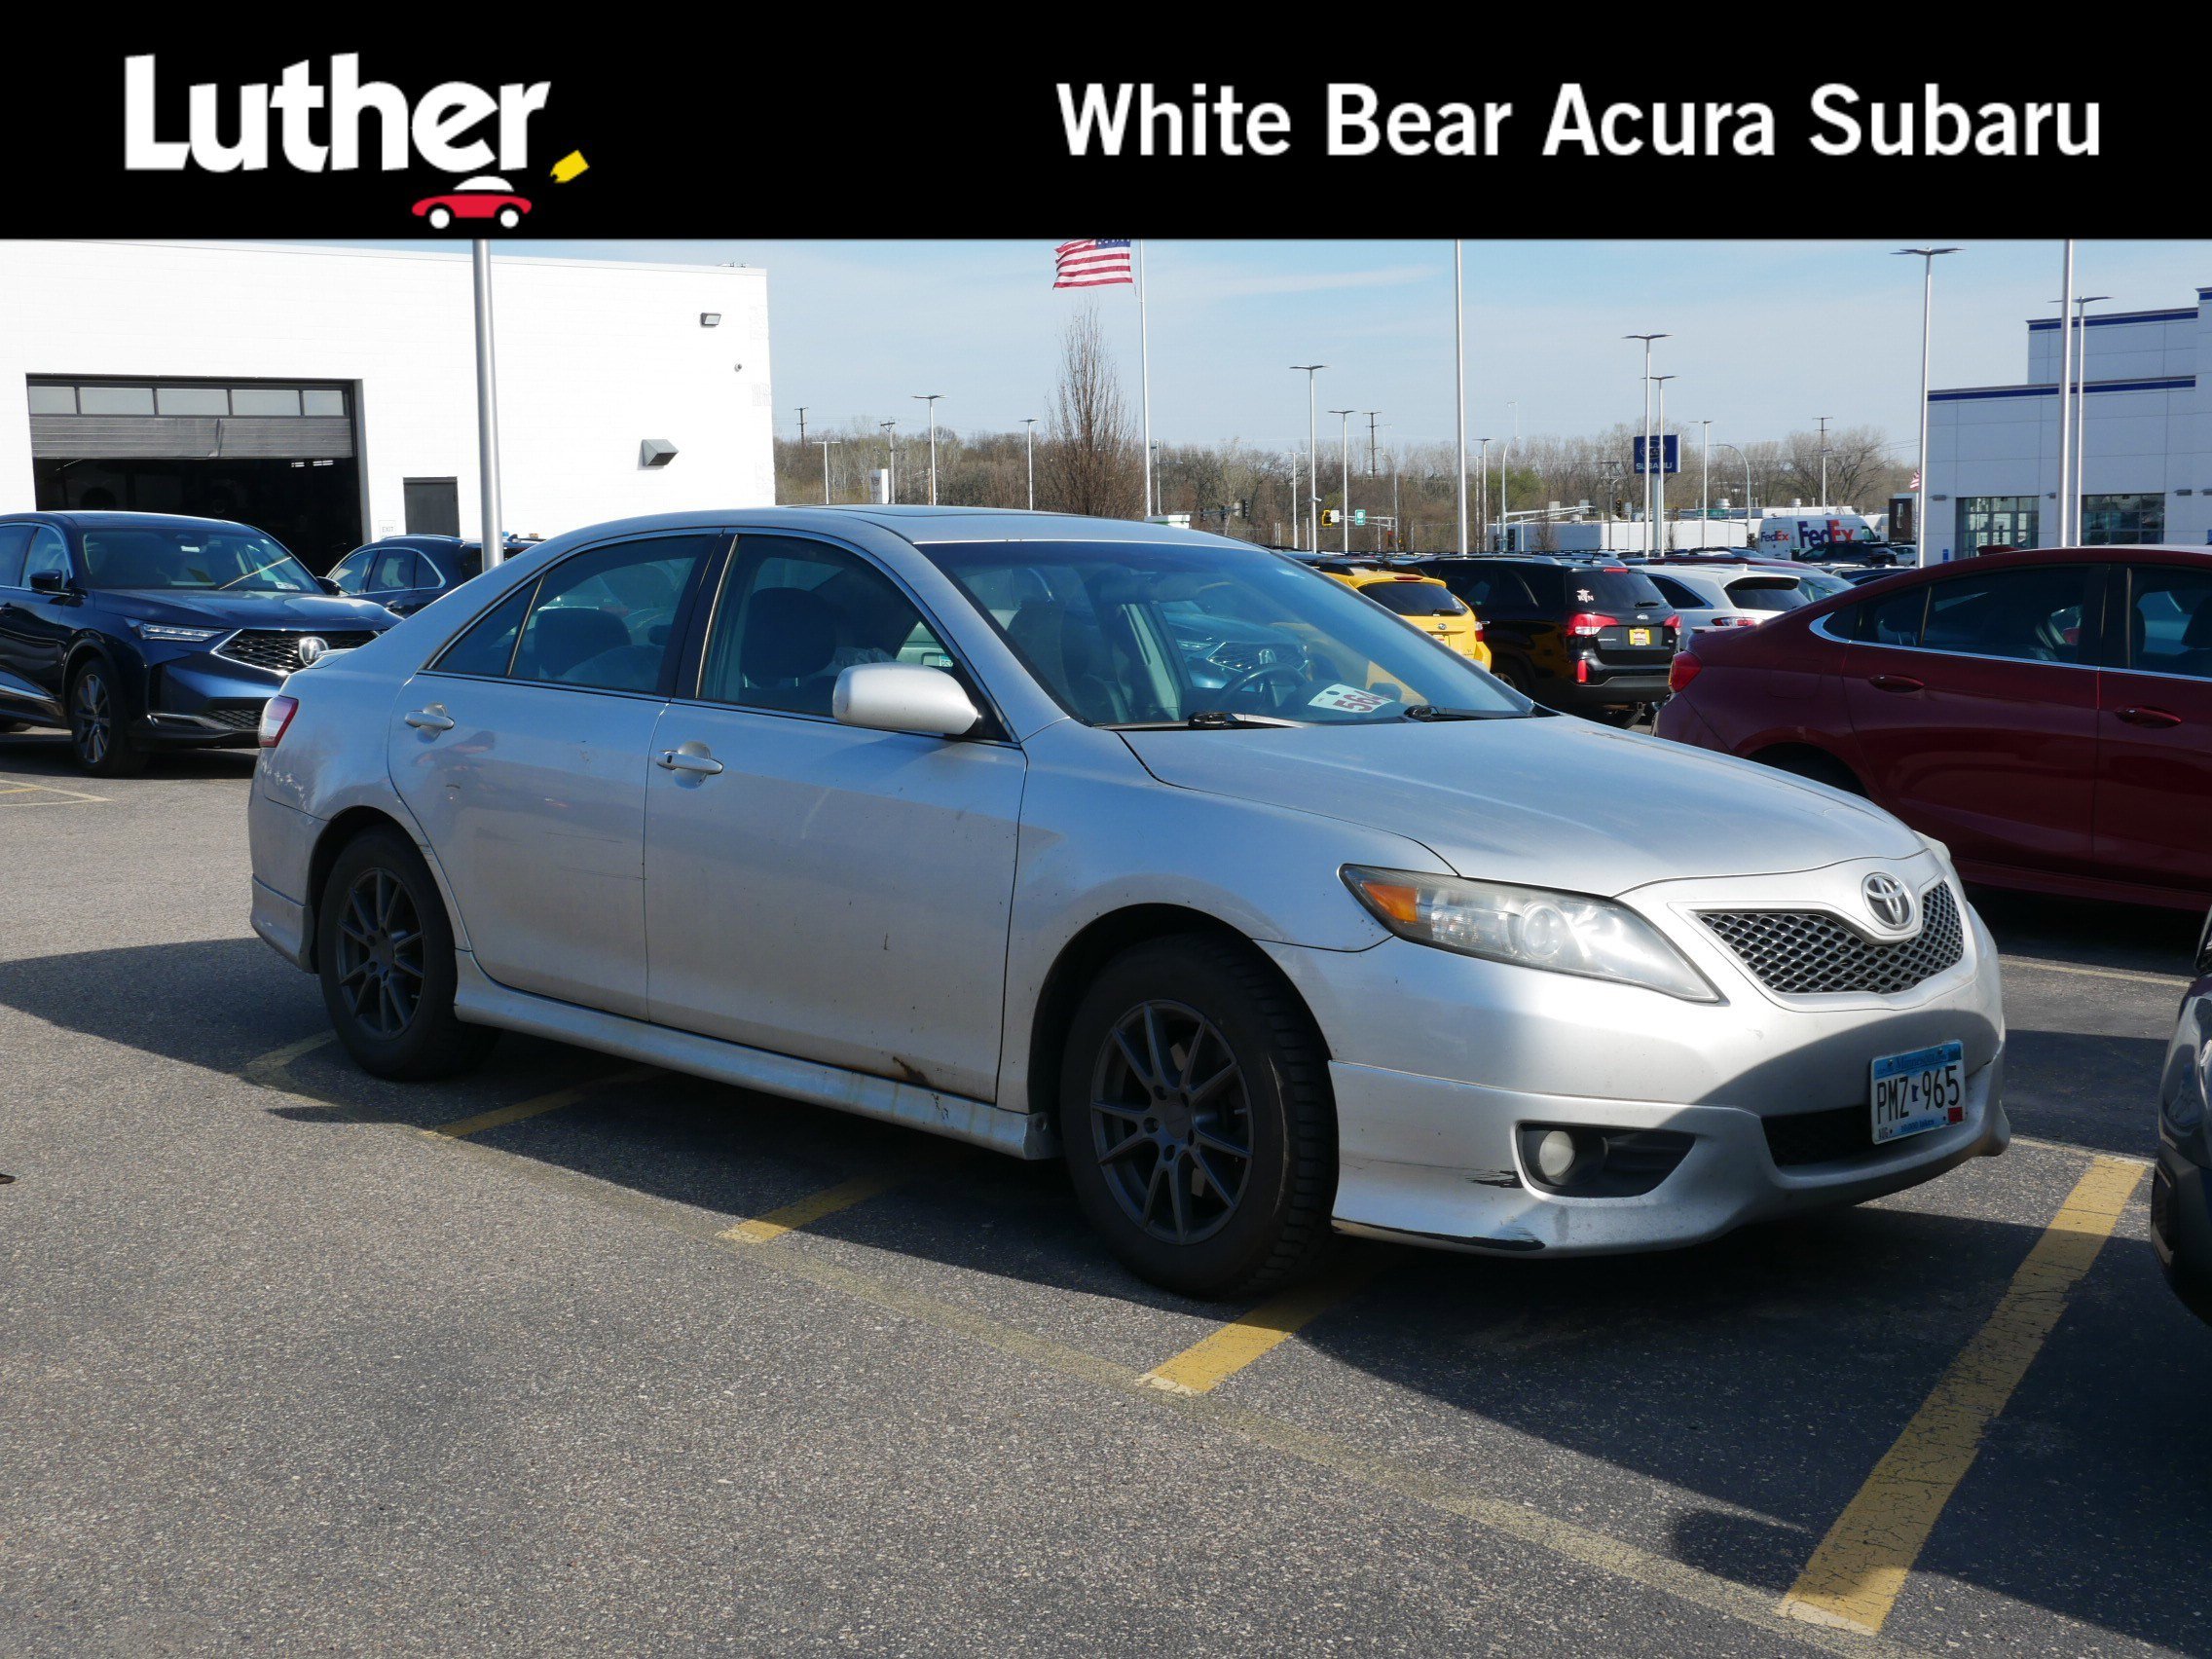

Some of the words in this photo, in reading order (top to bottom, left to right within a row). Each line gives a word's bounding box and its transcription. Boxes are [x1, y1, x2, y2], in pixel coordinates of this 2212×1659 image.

[1760, 530, 1789, 542] FedEx
[1797, 519, 1855, 548] FedEx
[1333, 690, 1390, 711] 564
[1876, 1076, 1909, 1124] PMZ
[1922, 1065, 1960, 1111] 965
